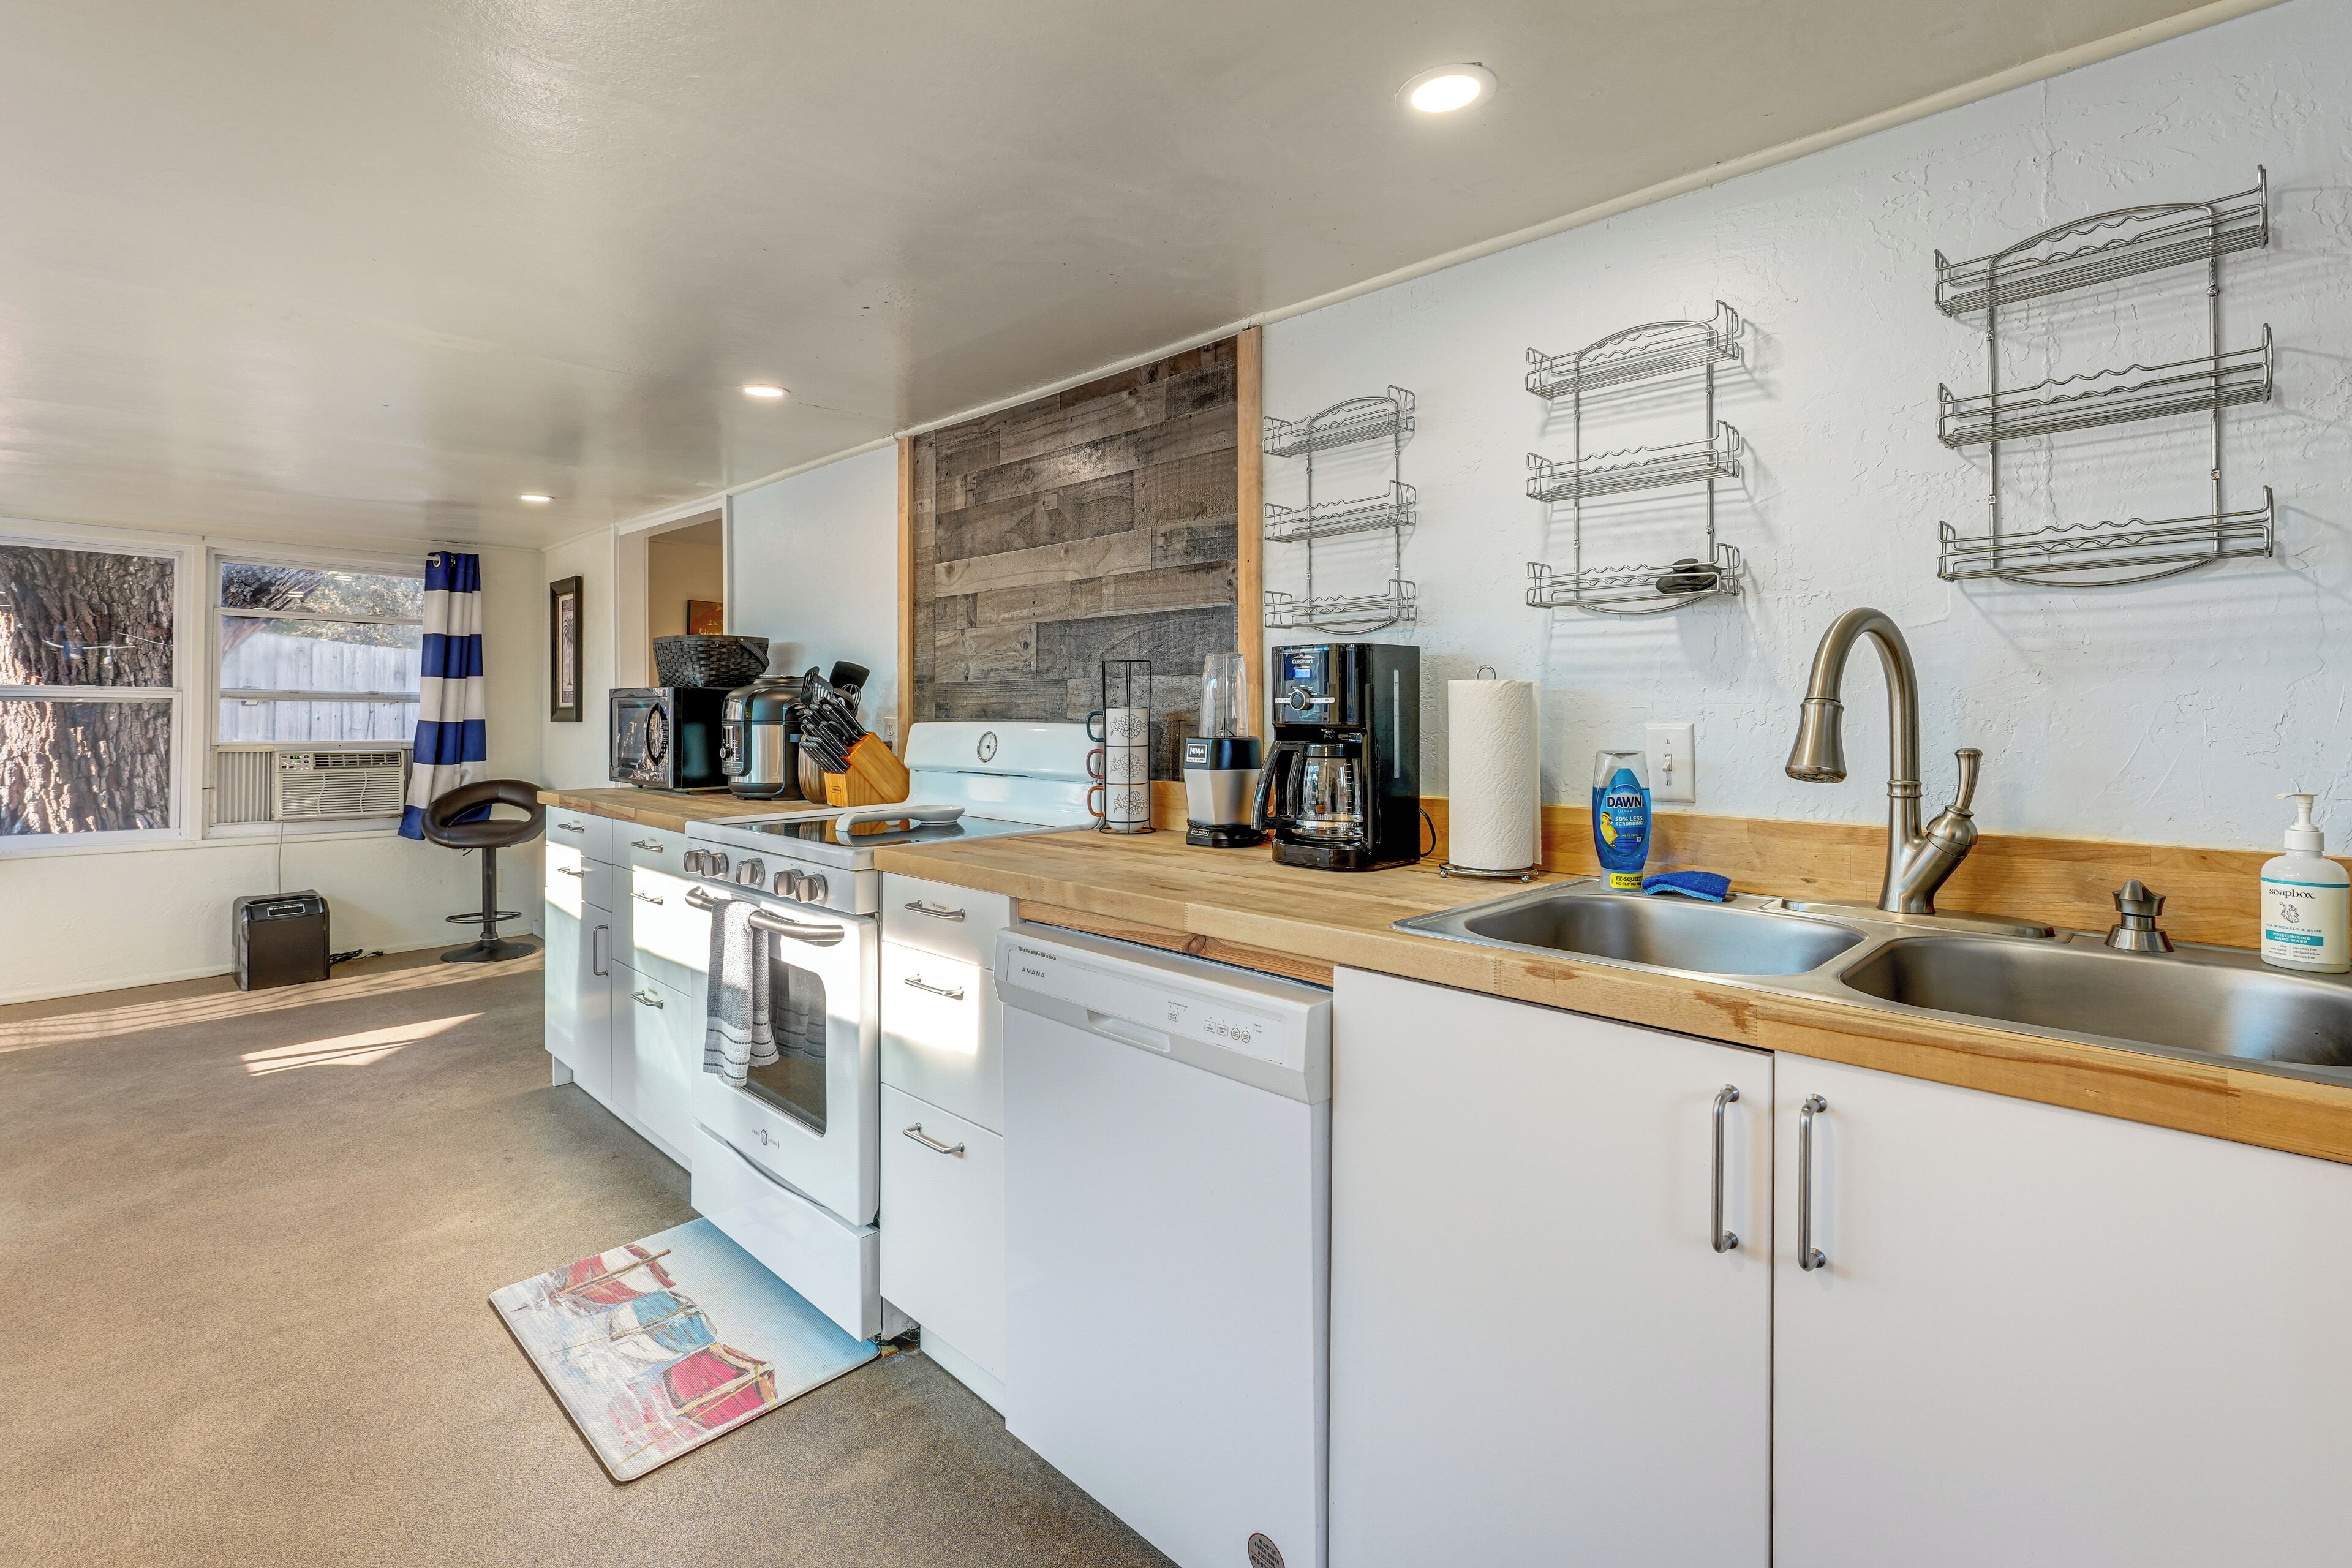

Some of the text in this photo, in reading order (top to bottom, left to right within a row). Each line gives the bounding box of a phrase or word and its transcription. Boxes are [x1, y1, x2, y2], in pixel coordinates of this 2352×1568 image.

[1607, 796, 1643, 808] DAWN
[2269, 888, 2313, 899] soapbox
[1022, 967, 1045, 978] AMANA
[1259, 1538, 1276, 1556] REGISTER
[1254, 1542, 1280, 1566] ENREGISTRER
